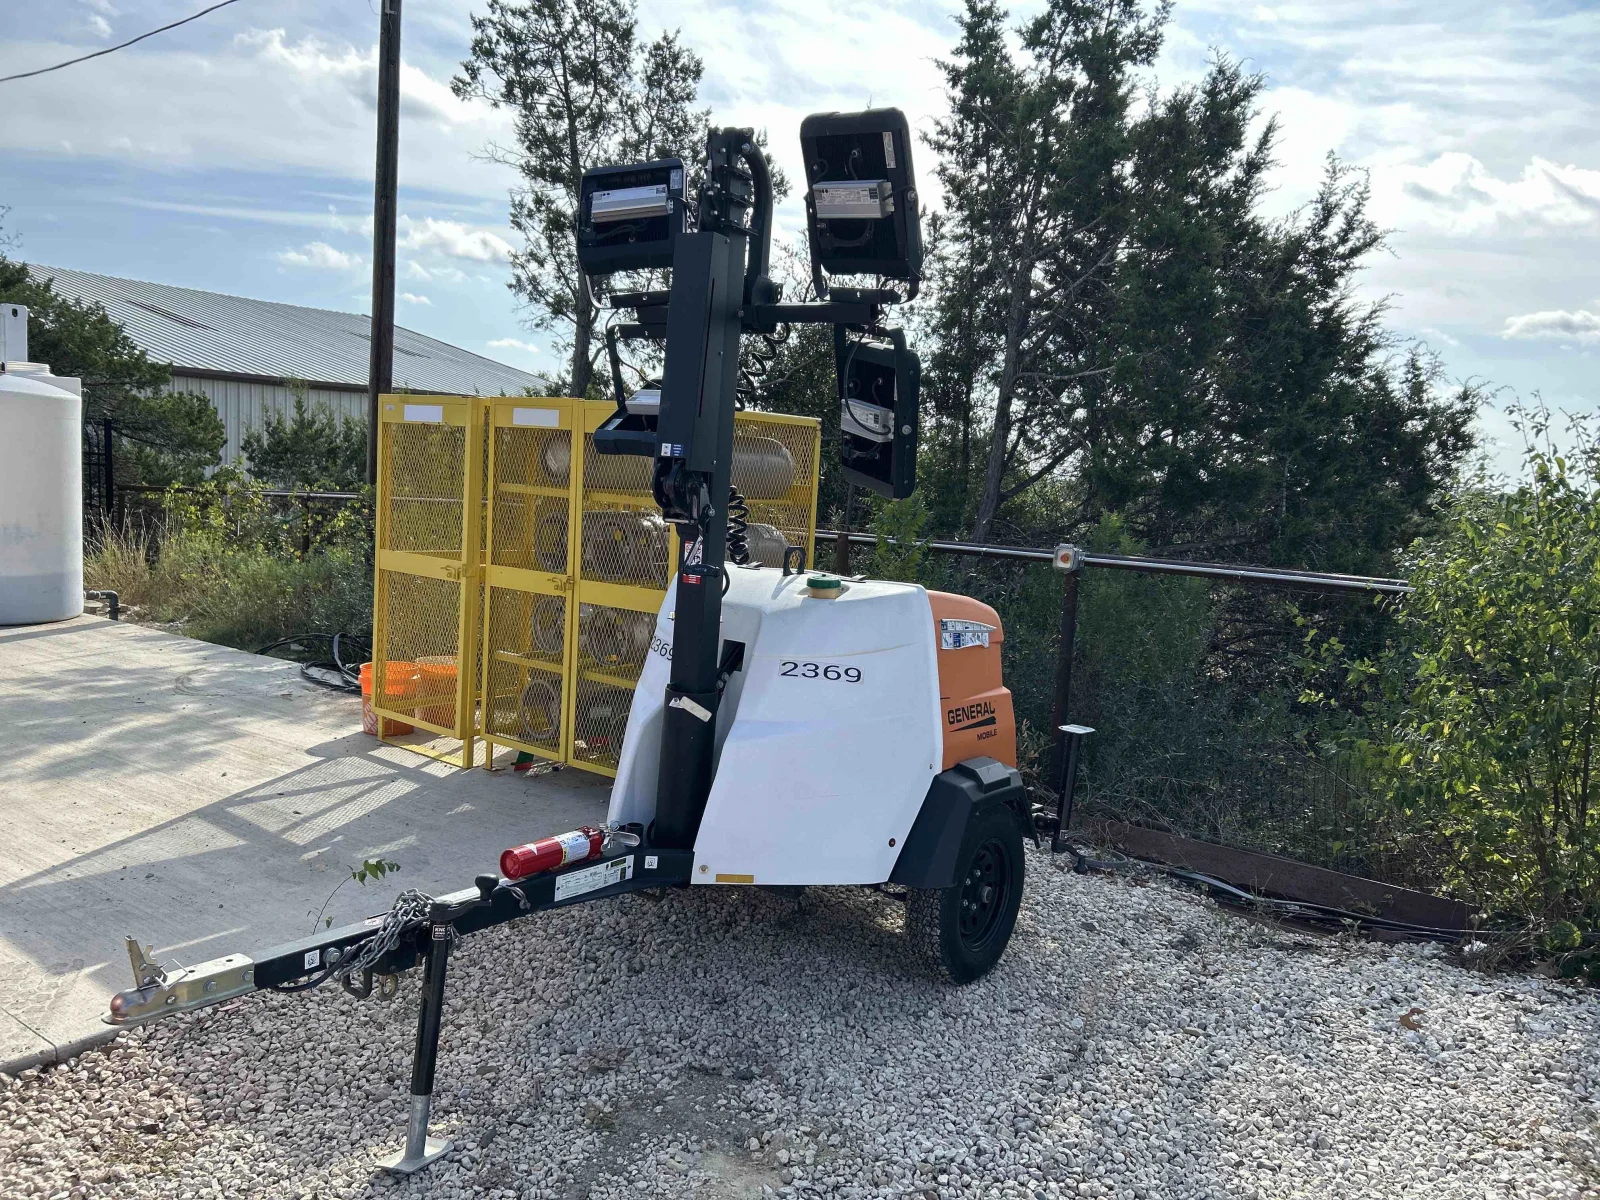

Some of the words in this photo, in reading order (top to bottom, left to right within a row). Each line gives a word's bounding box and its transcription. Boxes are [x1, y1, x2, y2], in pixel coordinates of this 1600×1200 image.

[780, 661, 862, 683] 2369
[947, 701, 996, 725] GENERAL
[976, 728, 998, 742] MOBILE
